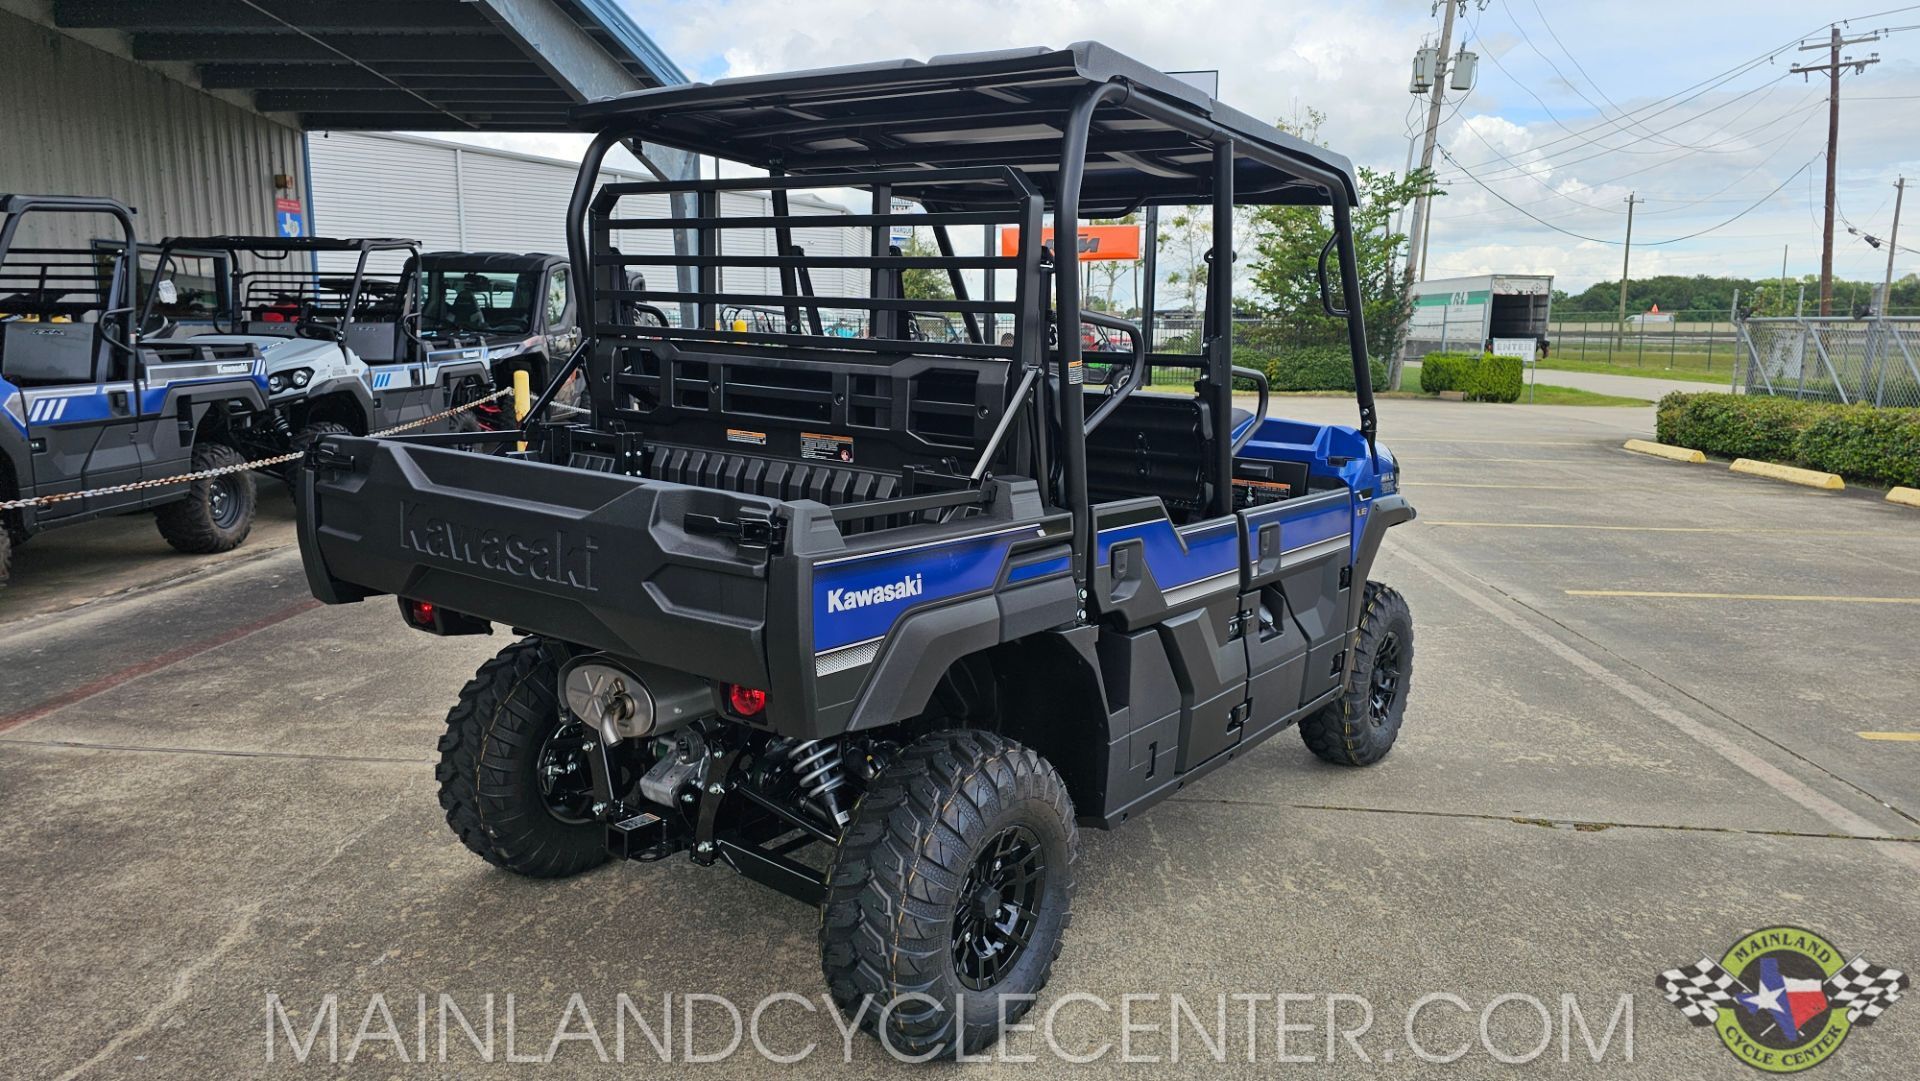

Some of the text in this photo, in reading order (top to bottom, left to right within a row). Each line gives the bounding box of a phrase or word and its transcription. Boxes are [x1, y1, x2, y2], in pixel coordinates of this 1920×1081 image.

[1496, 343, 1532, 351] ENTER
[400, 500, 599, 592] Kawasaki
[827, 573, 923, 614] Kawasaki
